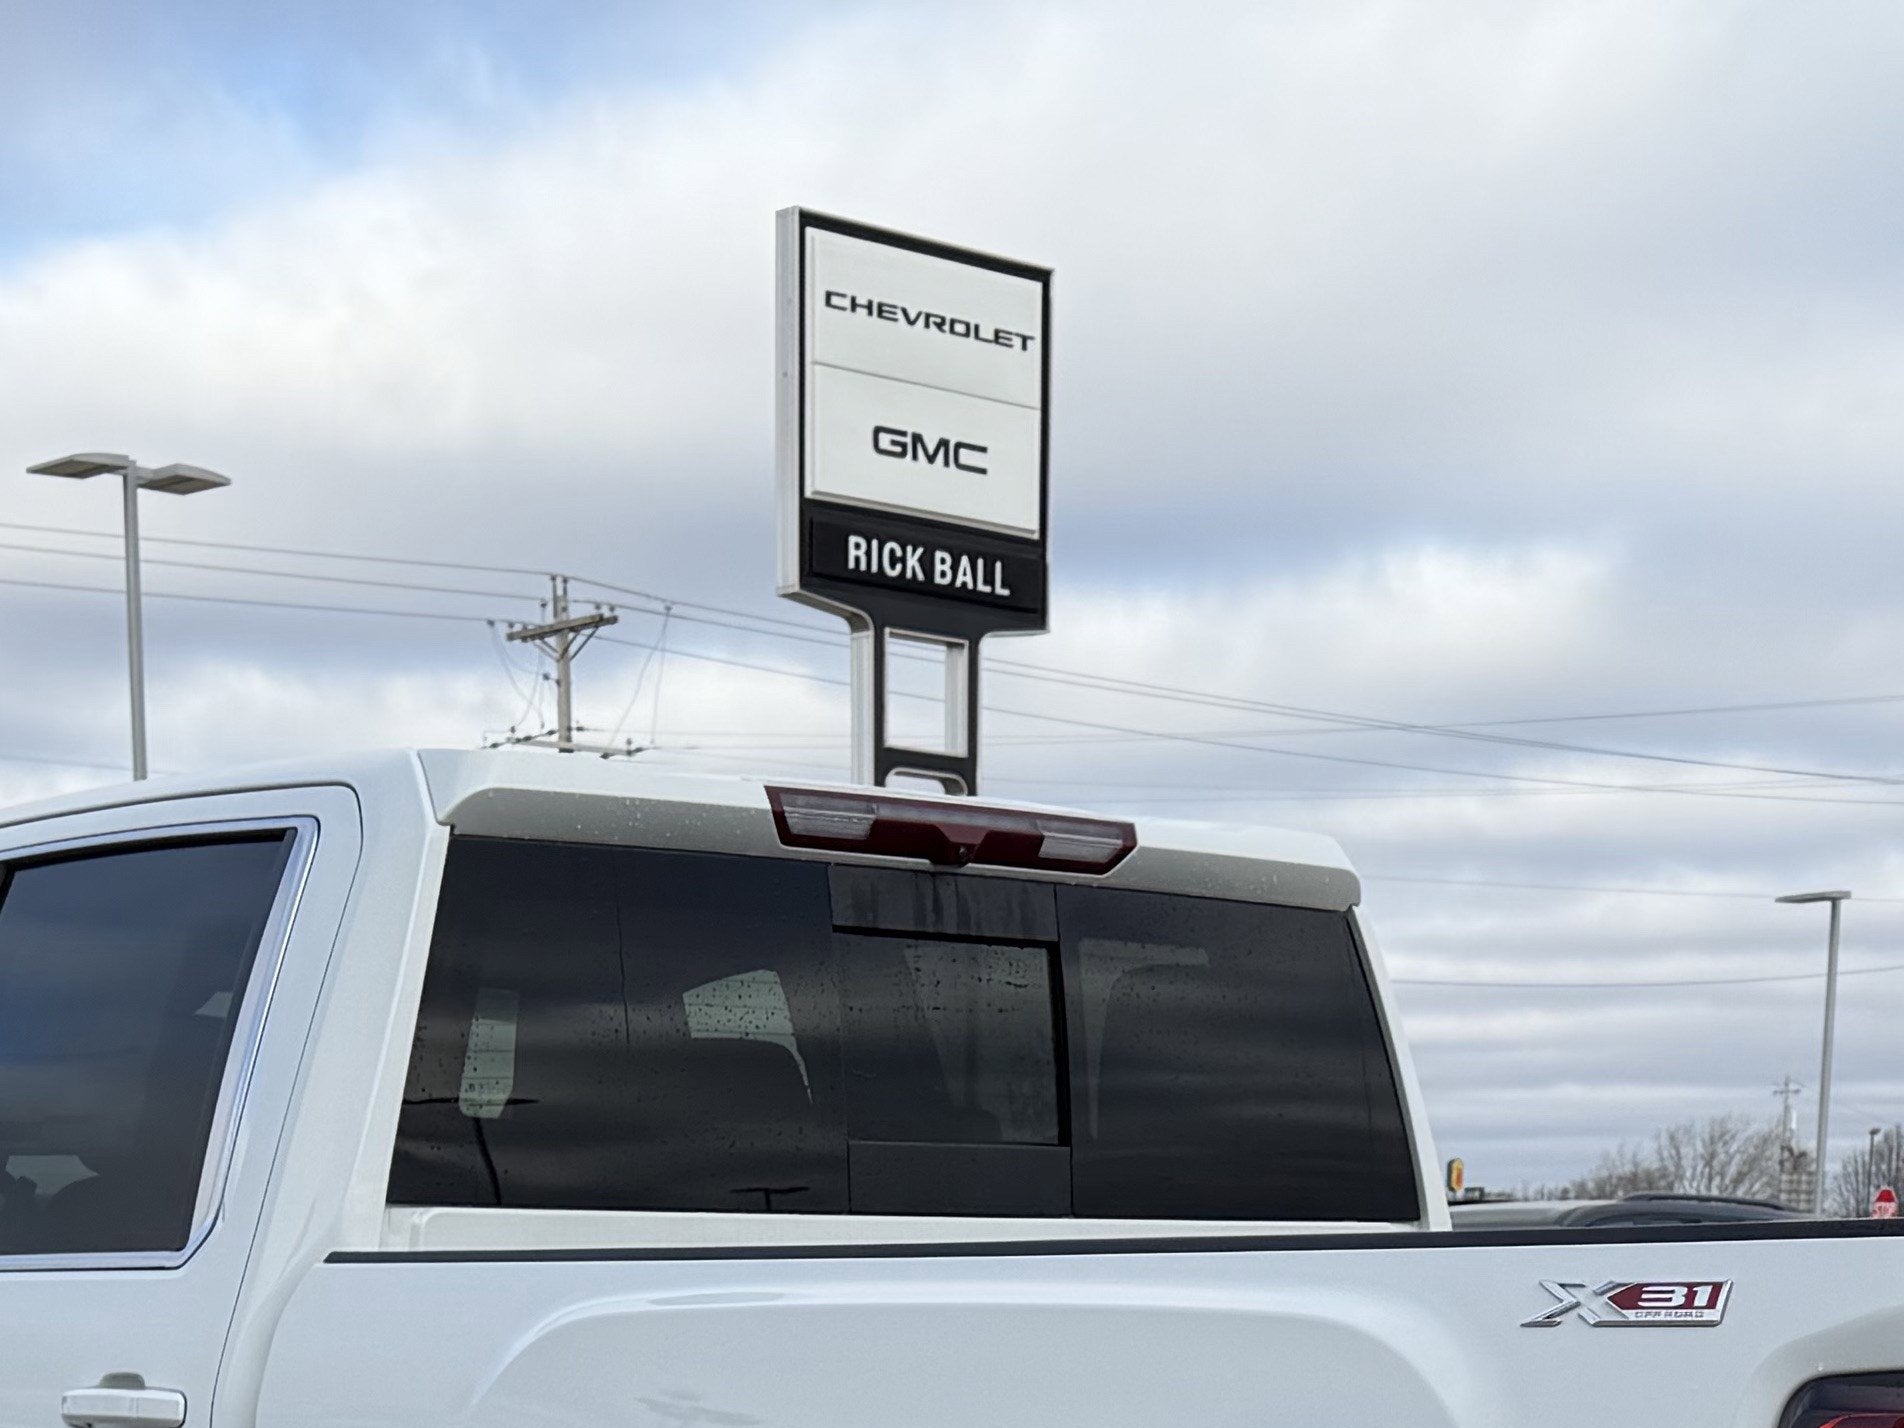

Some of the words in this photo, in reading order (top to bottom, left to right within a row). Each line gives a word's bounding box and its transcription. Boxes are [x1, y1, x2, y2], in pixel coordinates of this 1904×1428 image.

[824, 289, 1036, 352] CHEVROLET
[871, 424, 989, 476] GMC
[847, 534, 926, 583] RICK
[933, 549, 1012, 598] BALL
